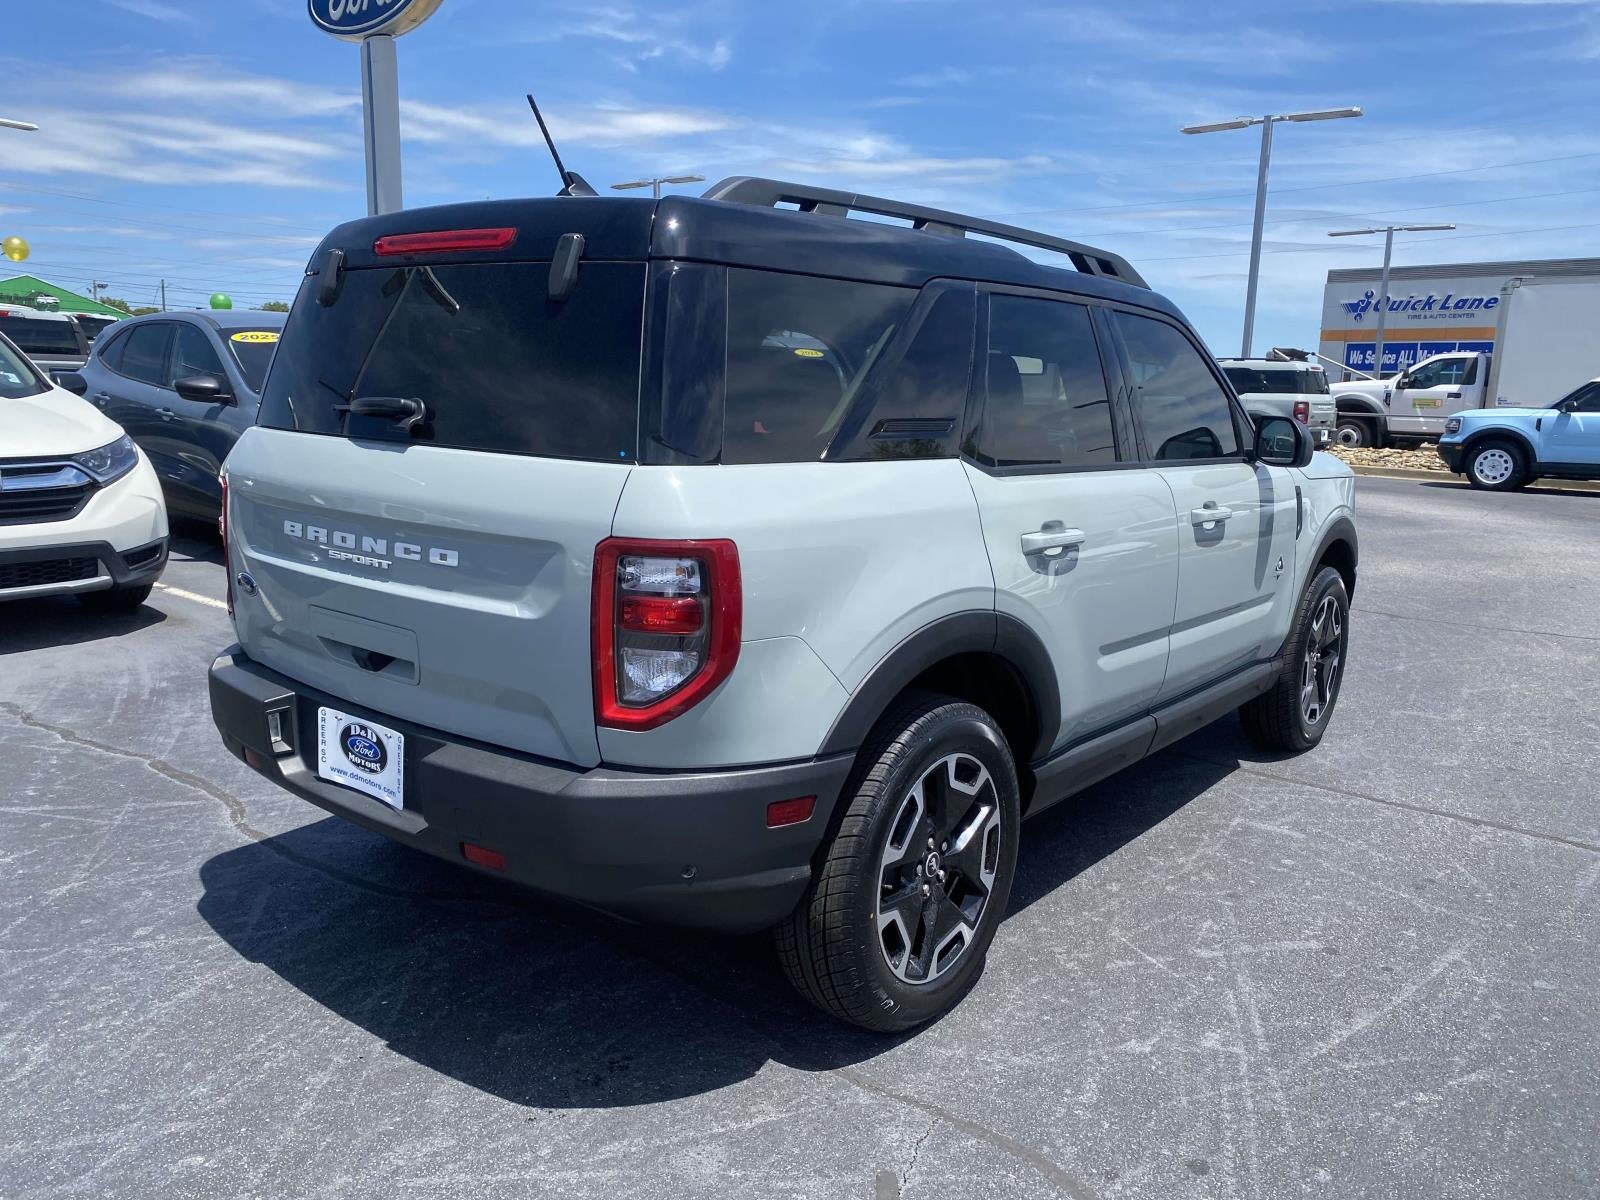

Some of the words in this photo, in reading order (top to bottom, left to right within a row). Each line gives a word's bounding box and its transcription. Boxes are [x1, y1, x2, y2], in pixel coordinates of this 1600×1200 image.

[1373, 295, 1437, 312] Quick
[1439, 294, 1499, 311] Lane
[1350, 350, 1364, 364] We
[1365, 350, 1397, 364] Seice
[1398, 350, 1414, 364] ALL
[283, 519, 459, 568] BRONCO
[328, 549, 393, 569] SPORT
[350, 724, 377, 743] D&D
[354, 740, 374, 758] Ford
[347, 751, 381, 772] MOTORS
[330, 766, 397, 797] www.ddmotors.com
